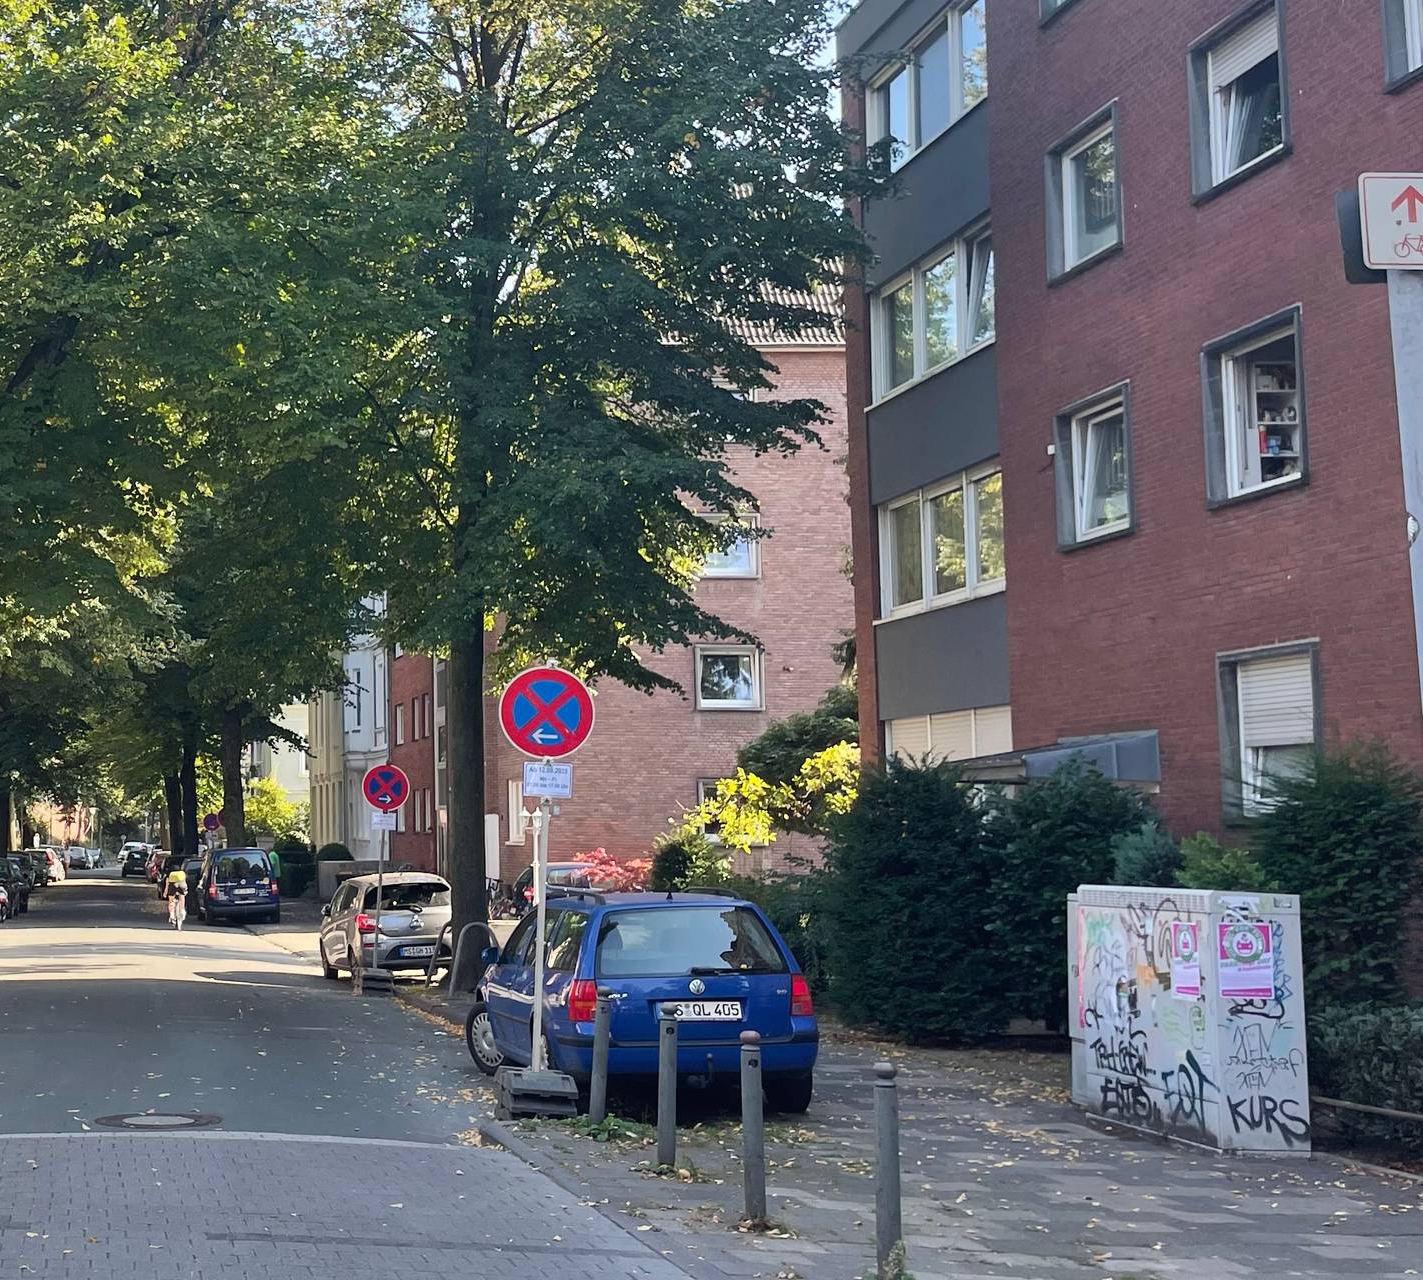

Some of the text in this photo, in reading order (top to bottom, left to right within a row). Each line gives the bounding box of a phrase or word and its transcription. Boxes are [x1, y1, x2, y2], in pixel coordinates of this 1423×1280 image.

[692, 1003, 711, 1016] QL
[714, 1003, 739, 1016] 405
[1226, 1095, 1311, 1147] KURS
